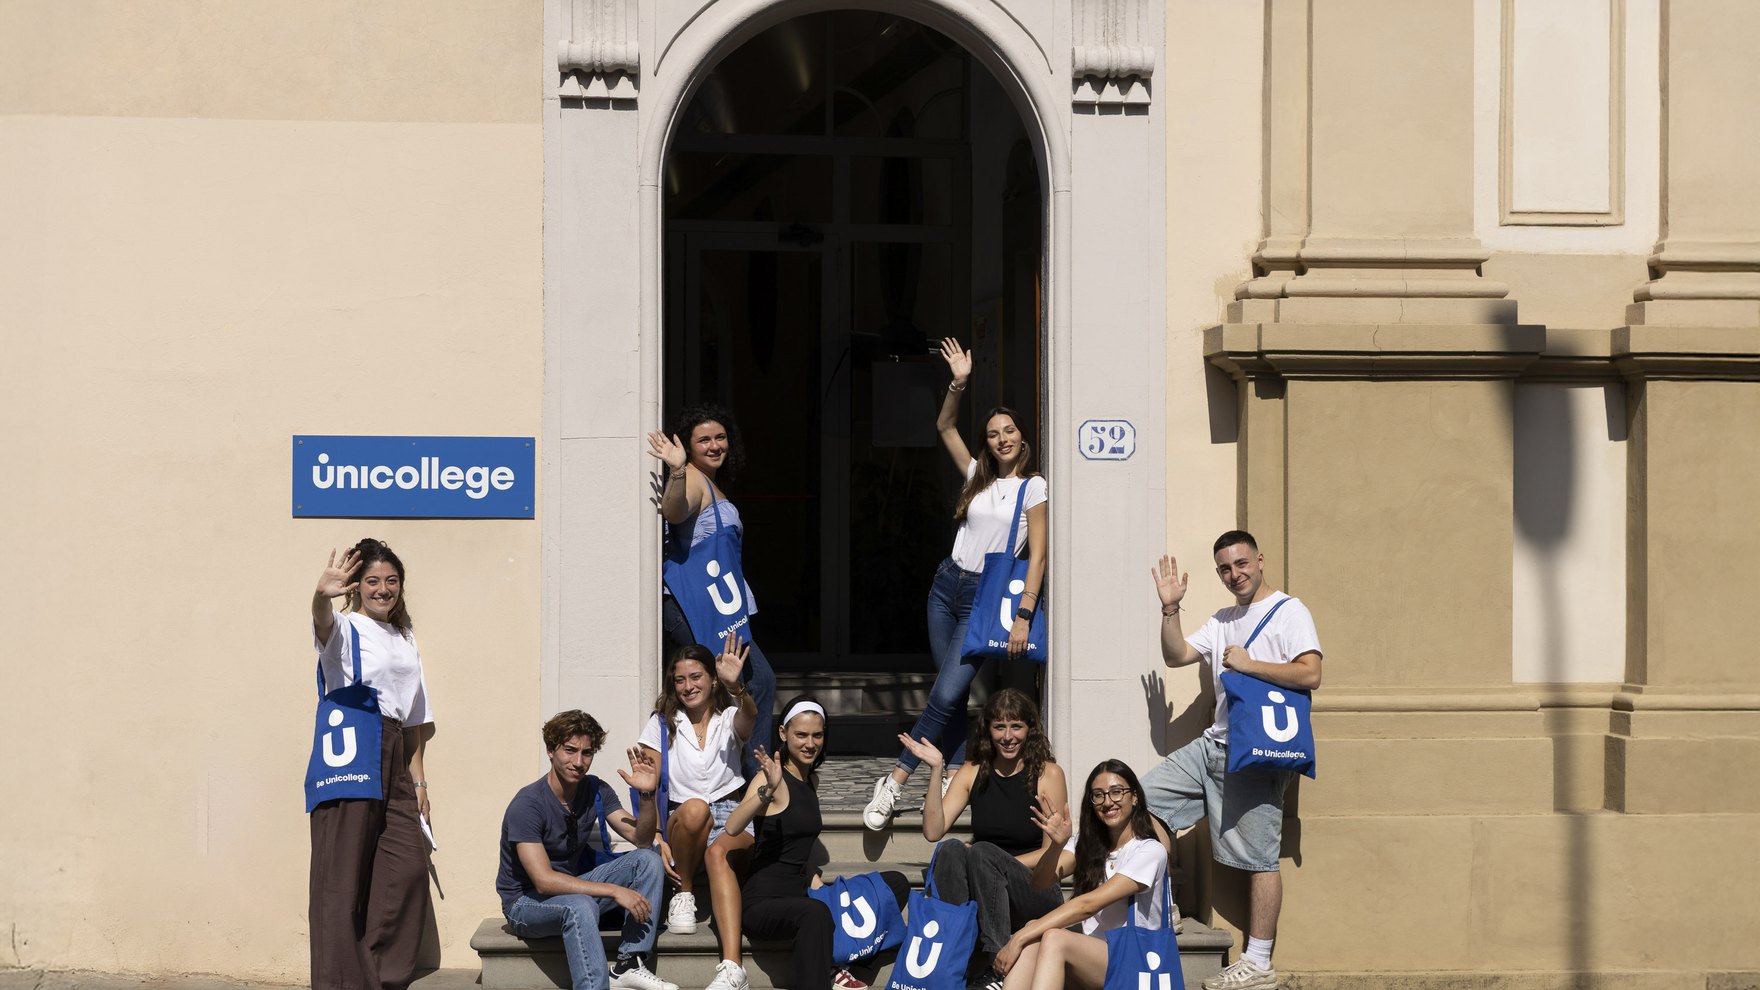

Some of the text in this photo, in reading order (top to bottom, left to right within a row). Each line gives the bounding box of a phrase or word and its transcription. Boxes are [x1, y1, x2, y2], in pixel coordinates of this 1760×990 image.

[1088, 425, 1126, 455] 52
[718, 630, 728, 639] Be
[988, 639, 999, 648] Be
[1252, 748, 1263, 756] Be
[325, 773, 371, 784] Unicollege.
[891, 981, 900, 990] Be
